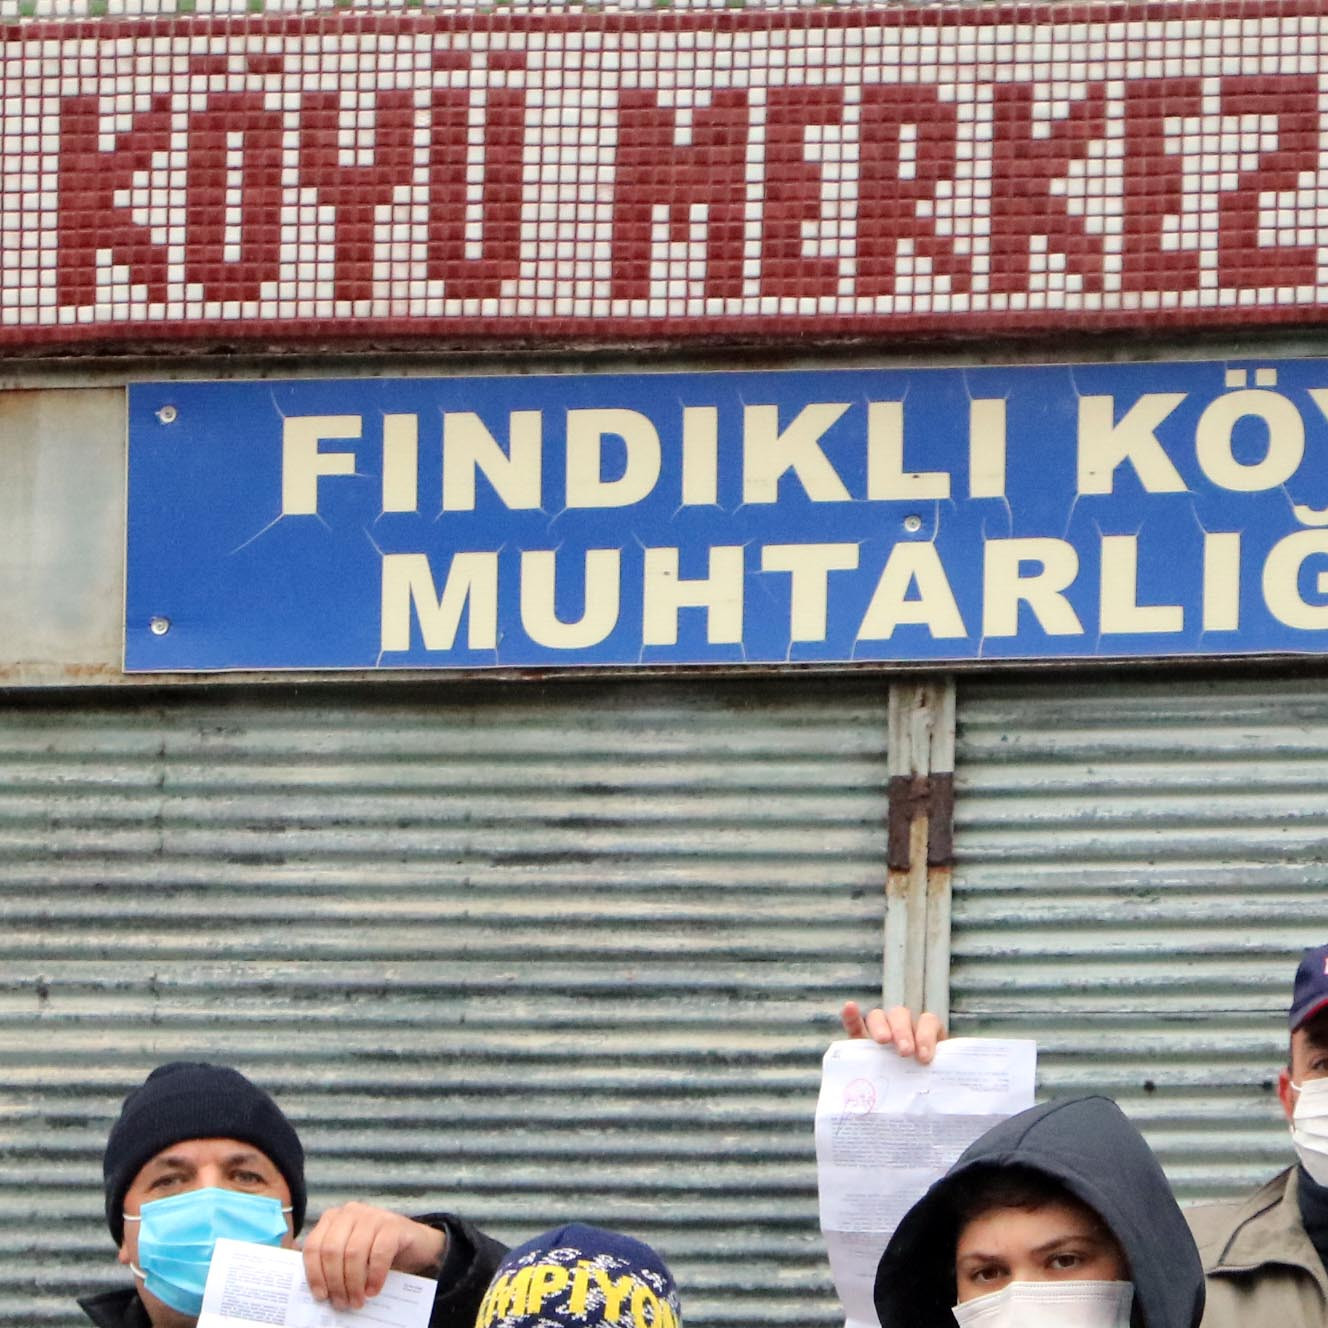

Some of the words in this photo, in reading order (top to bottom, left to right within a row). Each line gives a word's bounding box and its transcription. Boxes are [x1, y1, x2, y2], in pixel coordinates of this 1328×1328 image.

[57, 49, 526, 306] KÖYÜ
[611, 73, 1320, 299] MERKEZ
[282, 398, 1007, 516] FINDIKLI
